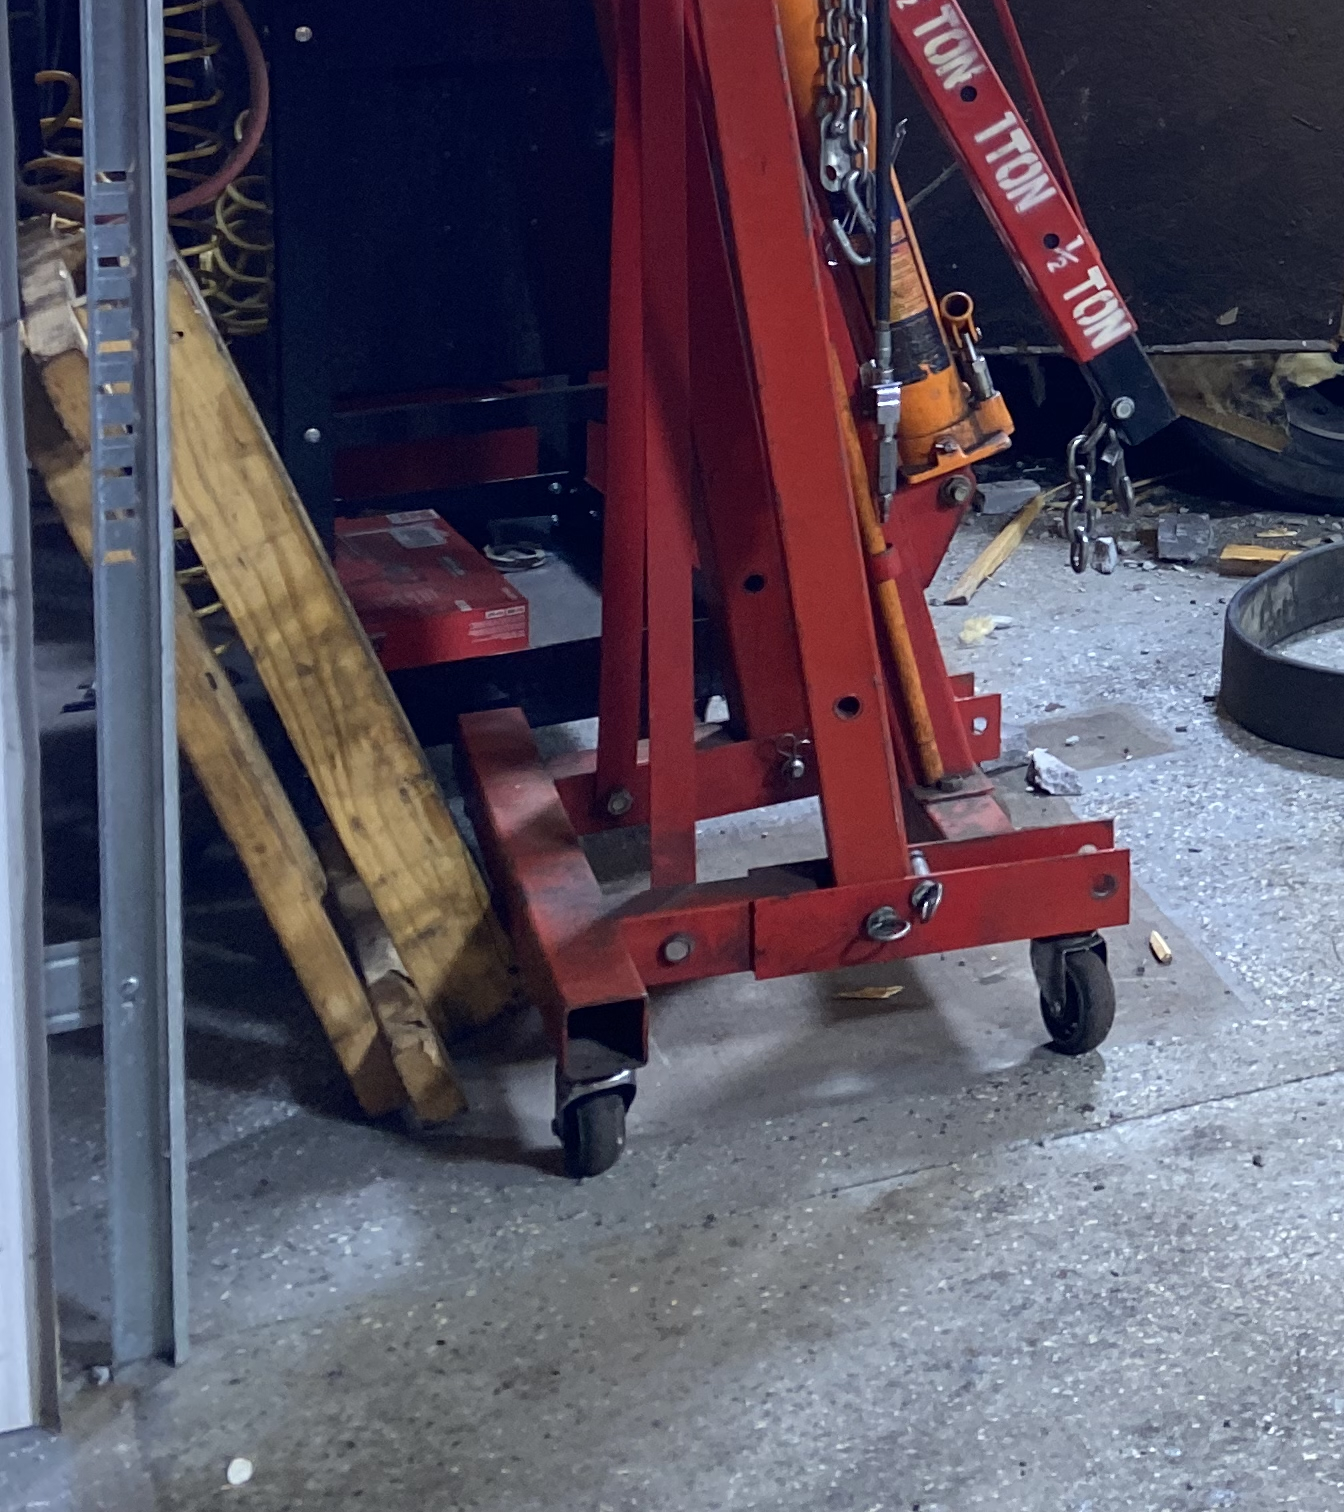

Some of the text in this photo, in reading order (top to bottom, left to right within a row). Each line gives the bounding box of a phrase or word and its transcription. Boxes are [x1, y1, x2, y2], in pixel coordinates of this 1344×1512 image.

[913, 3, 987, 90] TON
[985, 127, 1057, 214] TON
[1063, 265, 1133, 351] TON
